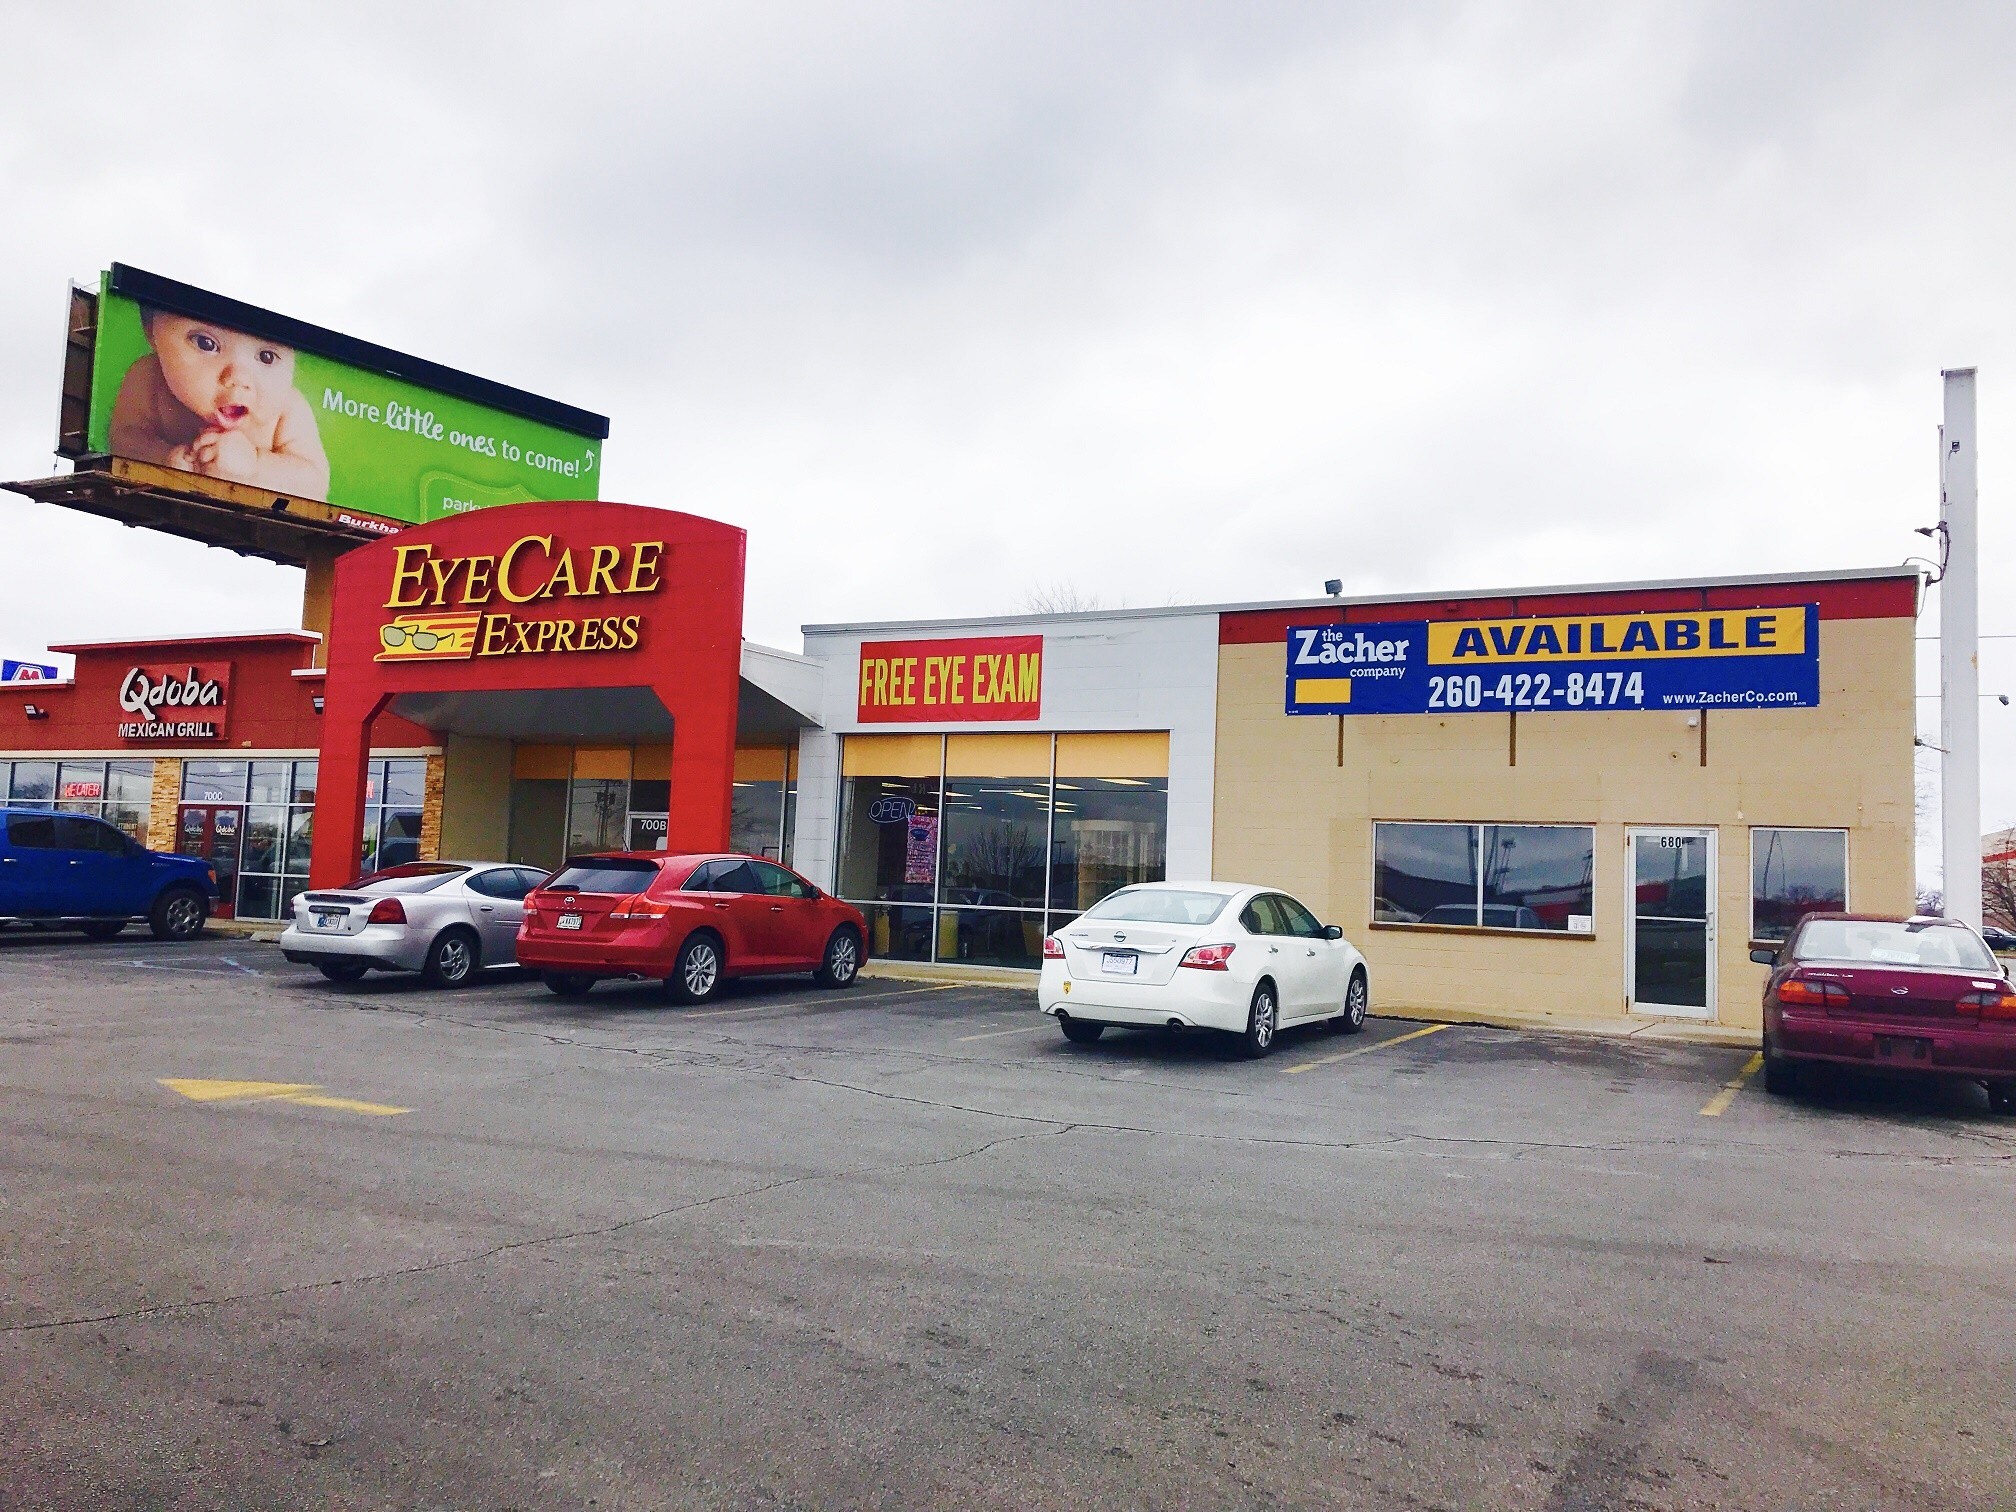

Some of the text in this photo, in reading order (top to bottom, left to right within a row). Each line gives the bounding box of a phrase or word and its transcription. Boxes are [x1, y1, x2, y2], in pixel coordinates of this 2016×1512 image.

[322, 388, 580, 478] More little ones to come!
[338, 514, 402, 534] Burkha
[477, 613, 641, 656] EXPRESS
[1322, 629, 1343, 642] the
[1452, 615, 1777, 658] AVAILABLE
[1295, 629, 1410, 665] Zacher
[860, 653, 1040, 706] FREE EYE EXAM
[1350, 666, 1406, 679] company
[119, 666, 218, 720] Qdoba
[1428, 671, 1644, 708] 260-422-8474
[1662, 690, 1798, 704] www.ZacherCo.com
[118, 722, 213, 738] MEXICAN GRILL
[870, 800, 912, 819] OPEN
[641, 819, 667, 831] 700B
[1661, 836, 1681, 848] 680
